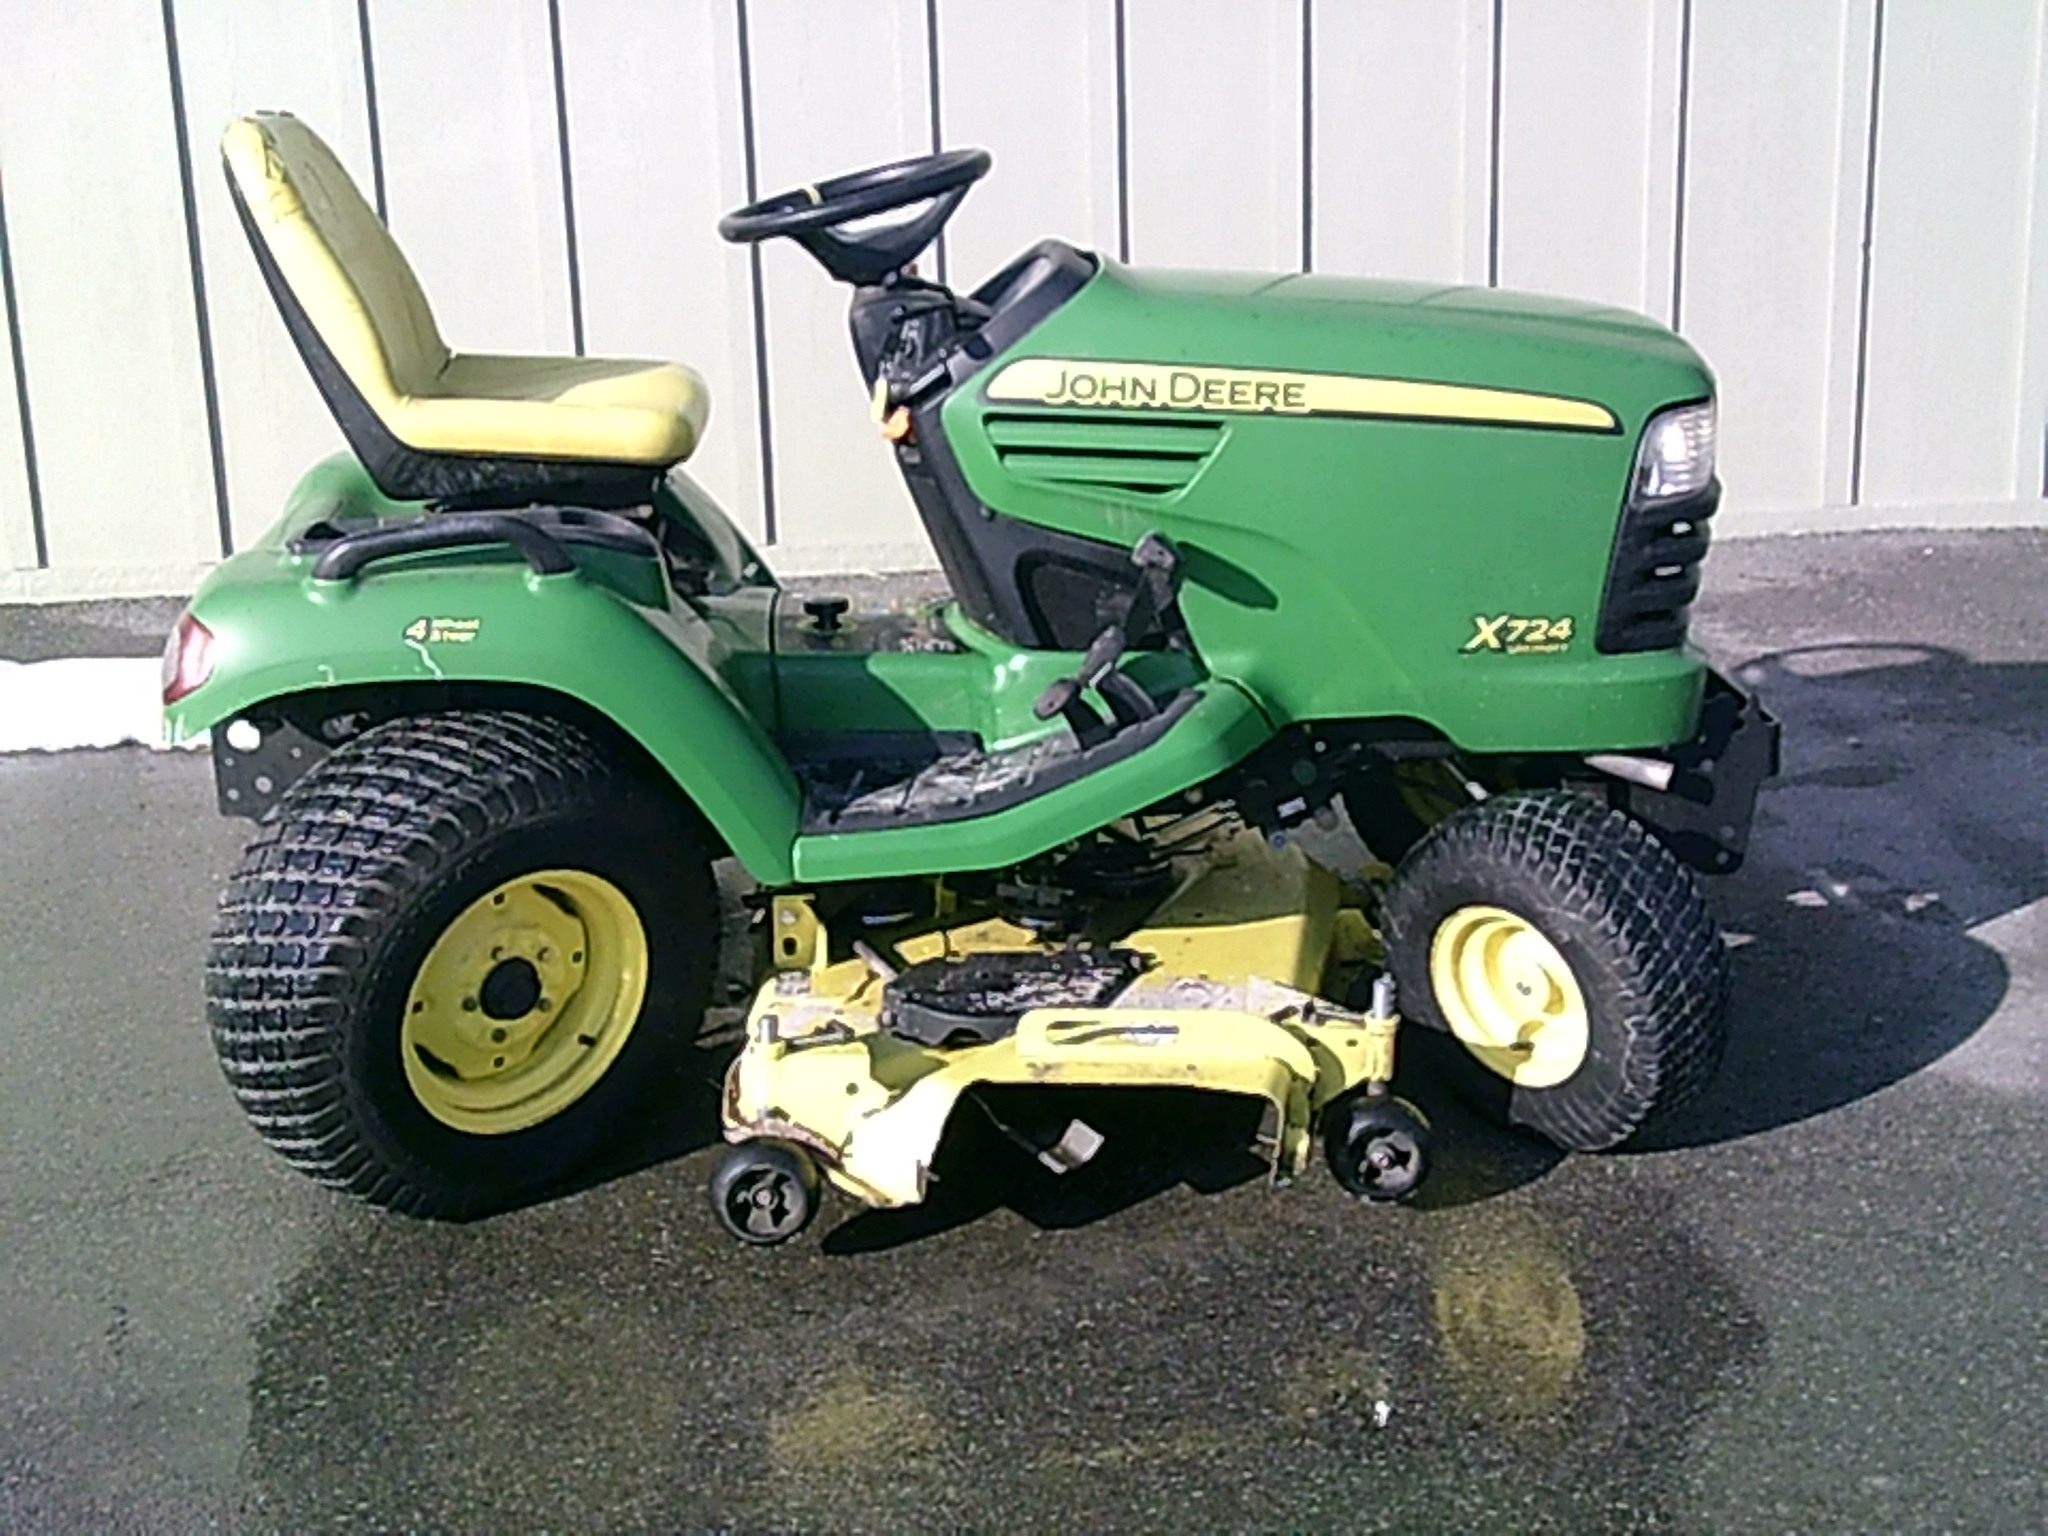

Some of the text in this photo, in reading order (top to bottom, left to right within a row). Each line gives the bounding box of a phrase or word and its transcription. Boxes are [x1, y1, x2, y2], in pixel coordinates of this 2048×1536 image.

[1045, 370, 1306, 407] JOHN DEERE
[405, 618, 428, 641] 4
[1463, 614, 1573, 649] X724
